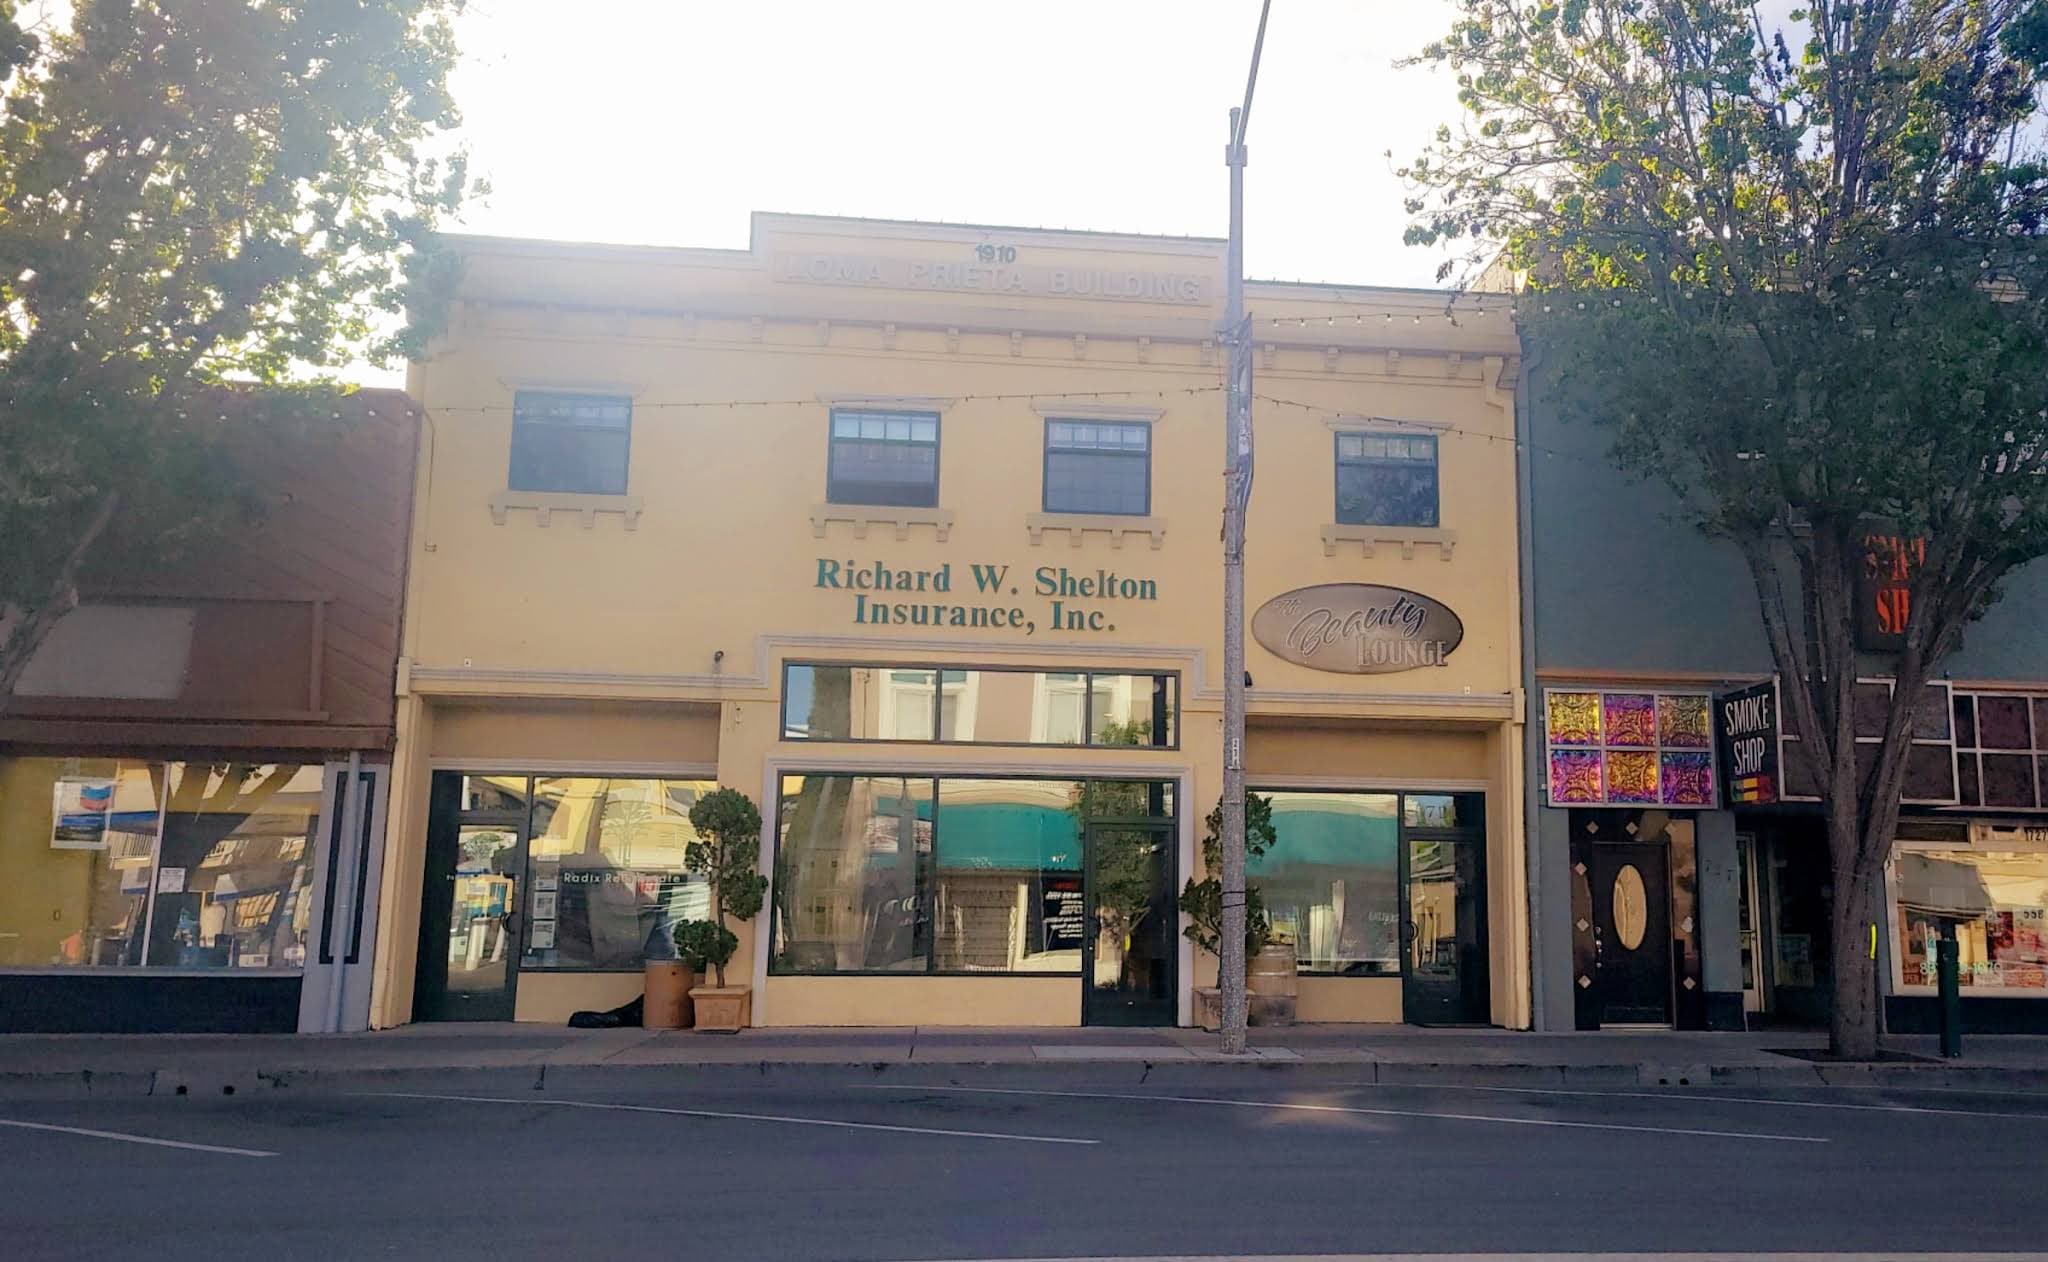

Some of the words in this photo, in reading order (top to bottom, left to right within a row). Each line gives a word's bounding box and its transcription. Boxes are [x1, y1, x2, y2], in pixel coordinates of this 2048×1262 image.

[975, 244, 1017, 263] 1910
[786, 255, 887, 283] LOMA
[909, 261, 1027, 292] PRIETA
[1048, 270, 1201, 301] BUILDING
[814, 558, 951, 593] Richard
[970, 564, 1018, 595] W.
[1035, 566, 1158, 601] Shelton
[853, 593, 1036, 636] Insurance,
[1049, 600, 1116, 633] Inc.
[1285, 595, 1428, 657] Beauty
[1356, 633, 1449, 668] LOUNGE
[1725, 693, 1770, 736] SMOKE
[1733, 737, 1766, 776] SHOP
[563, 871, 600, 884] Radix
